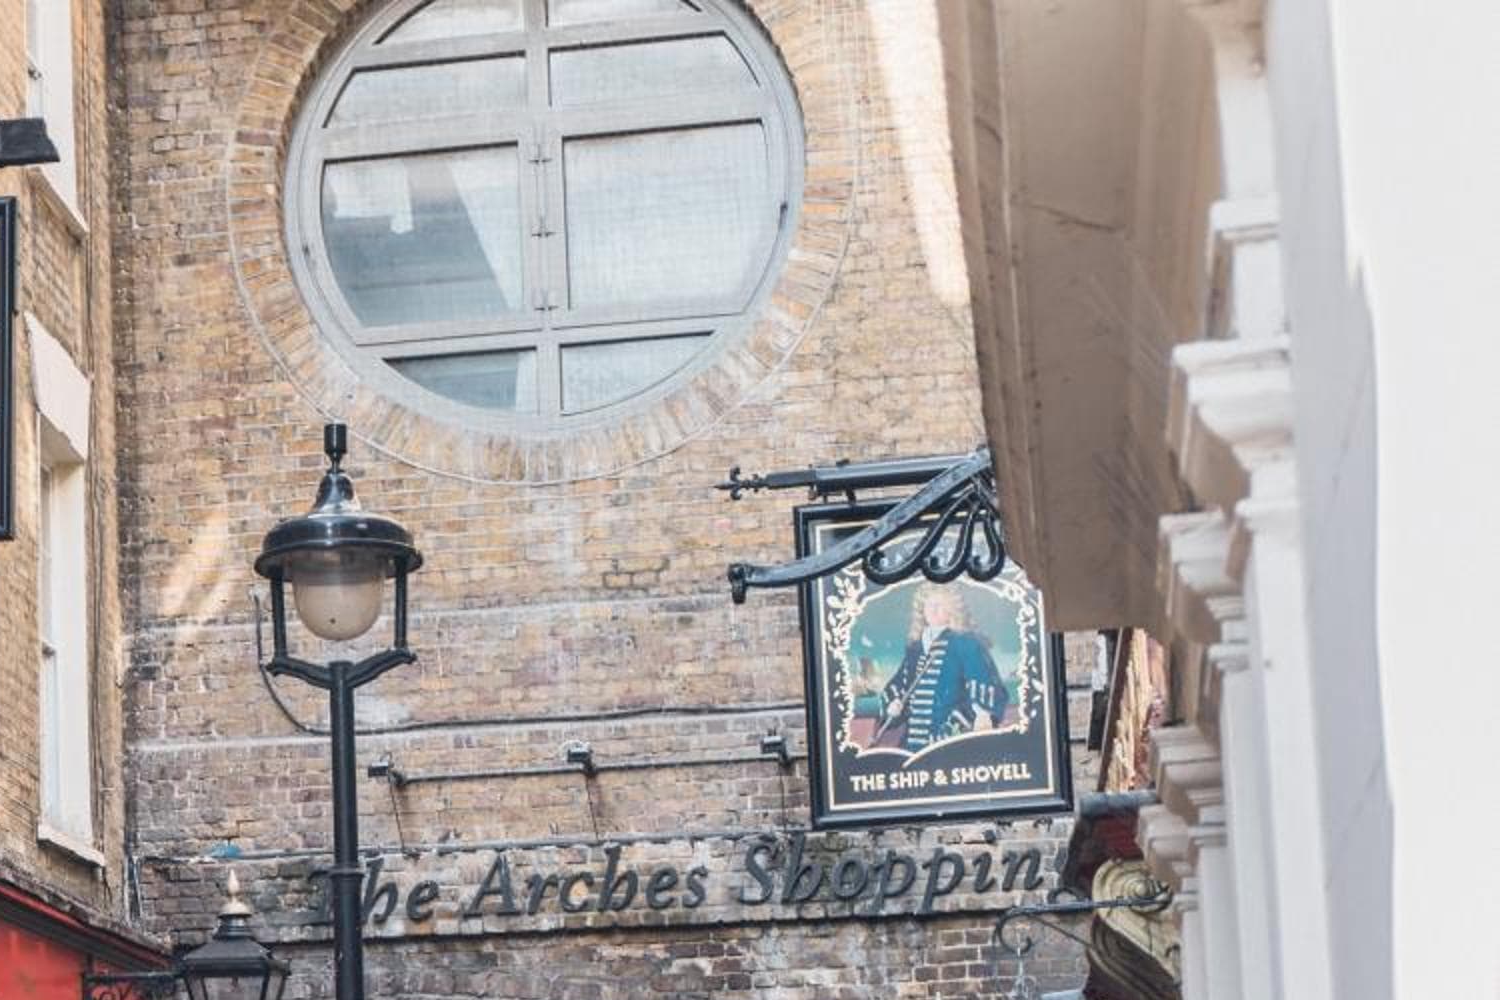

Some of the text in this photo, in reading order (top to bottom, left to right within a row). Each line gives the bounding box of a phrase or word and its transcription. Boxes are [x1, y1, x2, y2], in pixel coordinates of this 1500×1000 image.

[850, 762, 1032, 792] THE SHIP & SHOVELL
[463, 842, 708, 918] Arches
[739, 829, 1068, 914] Shoppin
